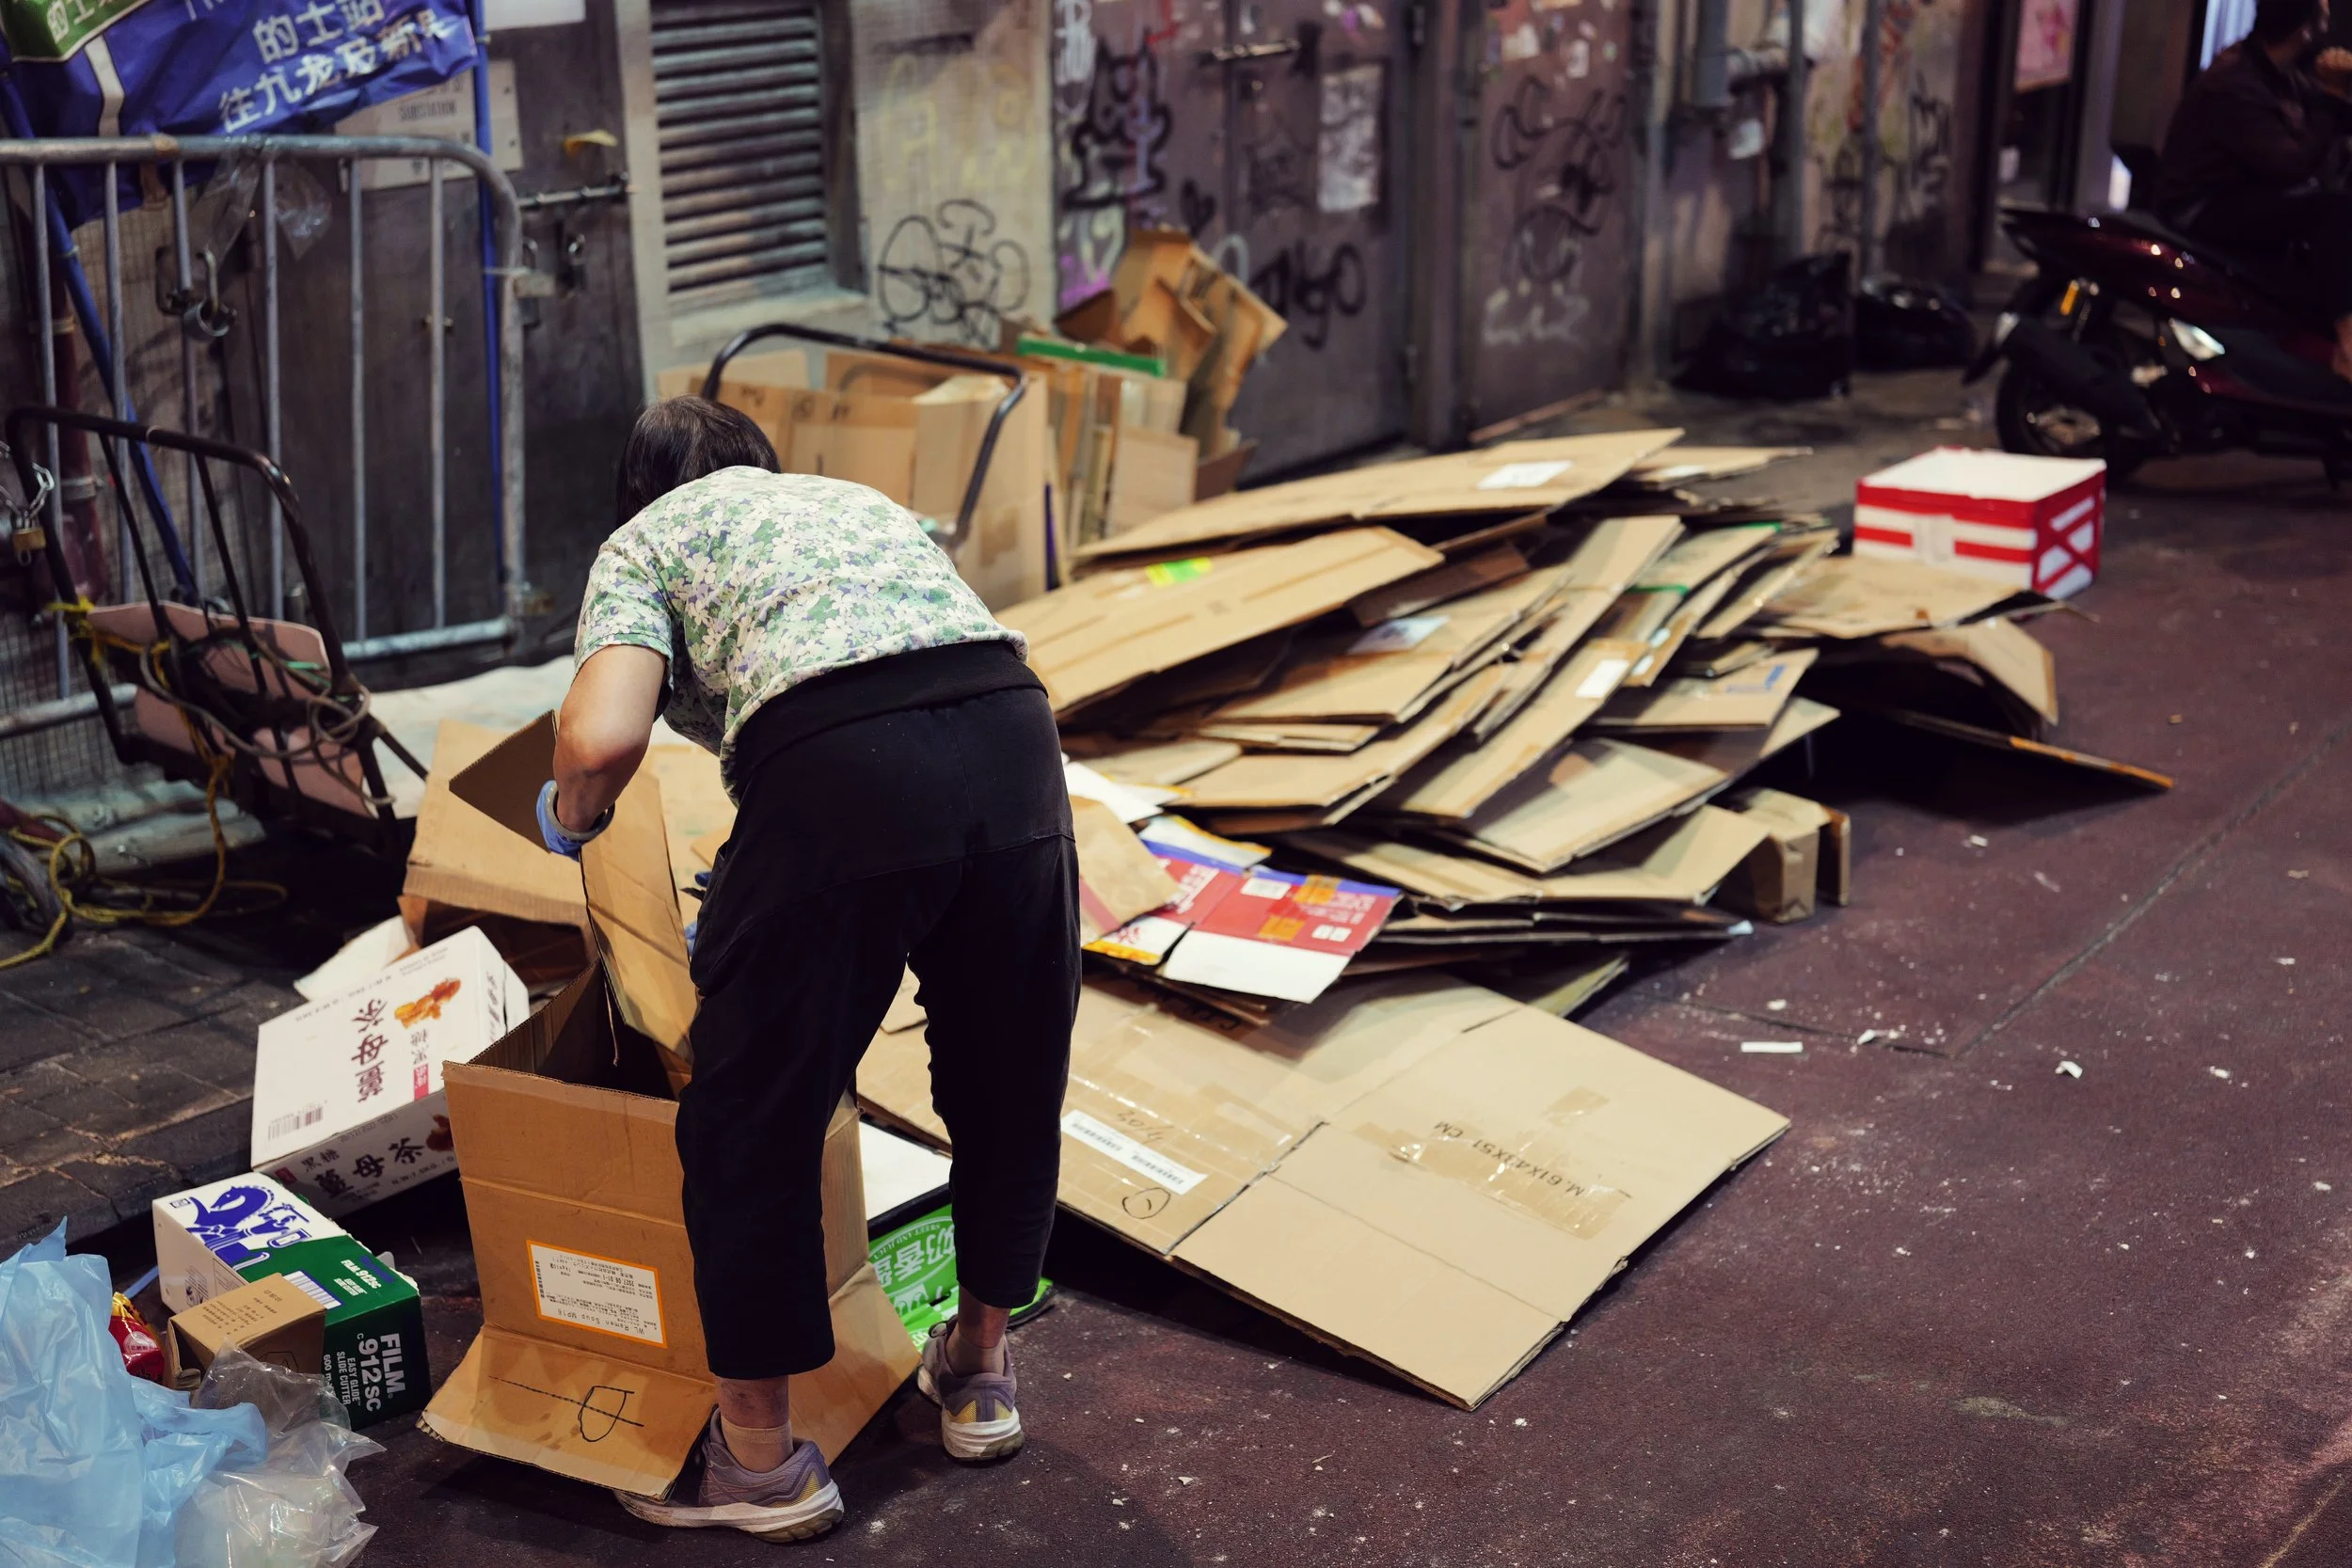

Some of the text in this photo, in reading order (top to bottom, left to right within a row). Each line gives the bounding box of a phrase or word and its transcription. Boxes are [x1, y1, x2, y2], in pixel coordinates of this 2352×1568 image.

[1434, 1120, 1464, 1138] CM
[898, 1232, 914, 1244] AND
[580, 1313, 601, 1325] Soup
[605, 1320, 629, 1332] Ramen
[323, 1354, 332, 1371] 600
[347, 1357, 358, 1377] EASY
[337, 1351, 352, 1405] SLIDE CUTTER
